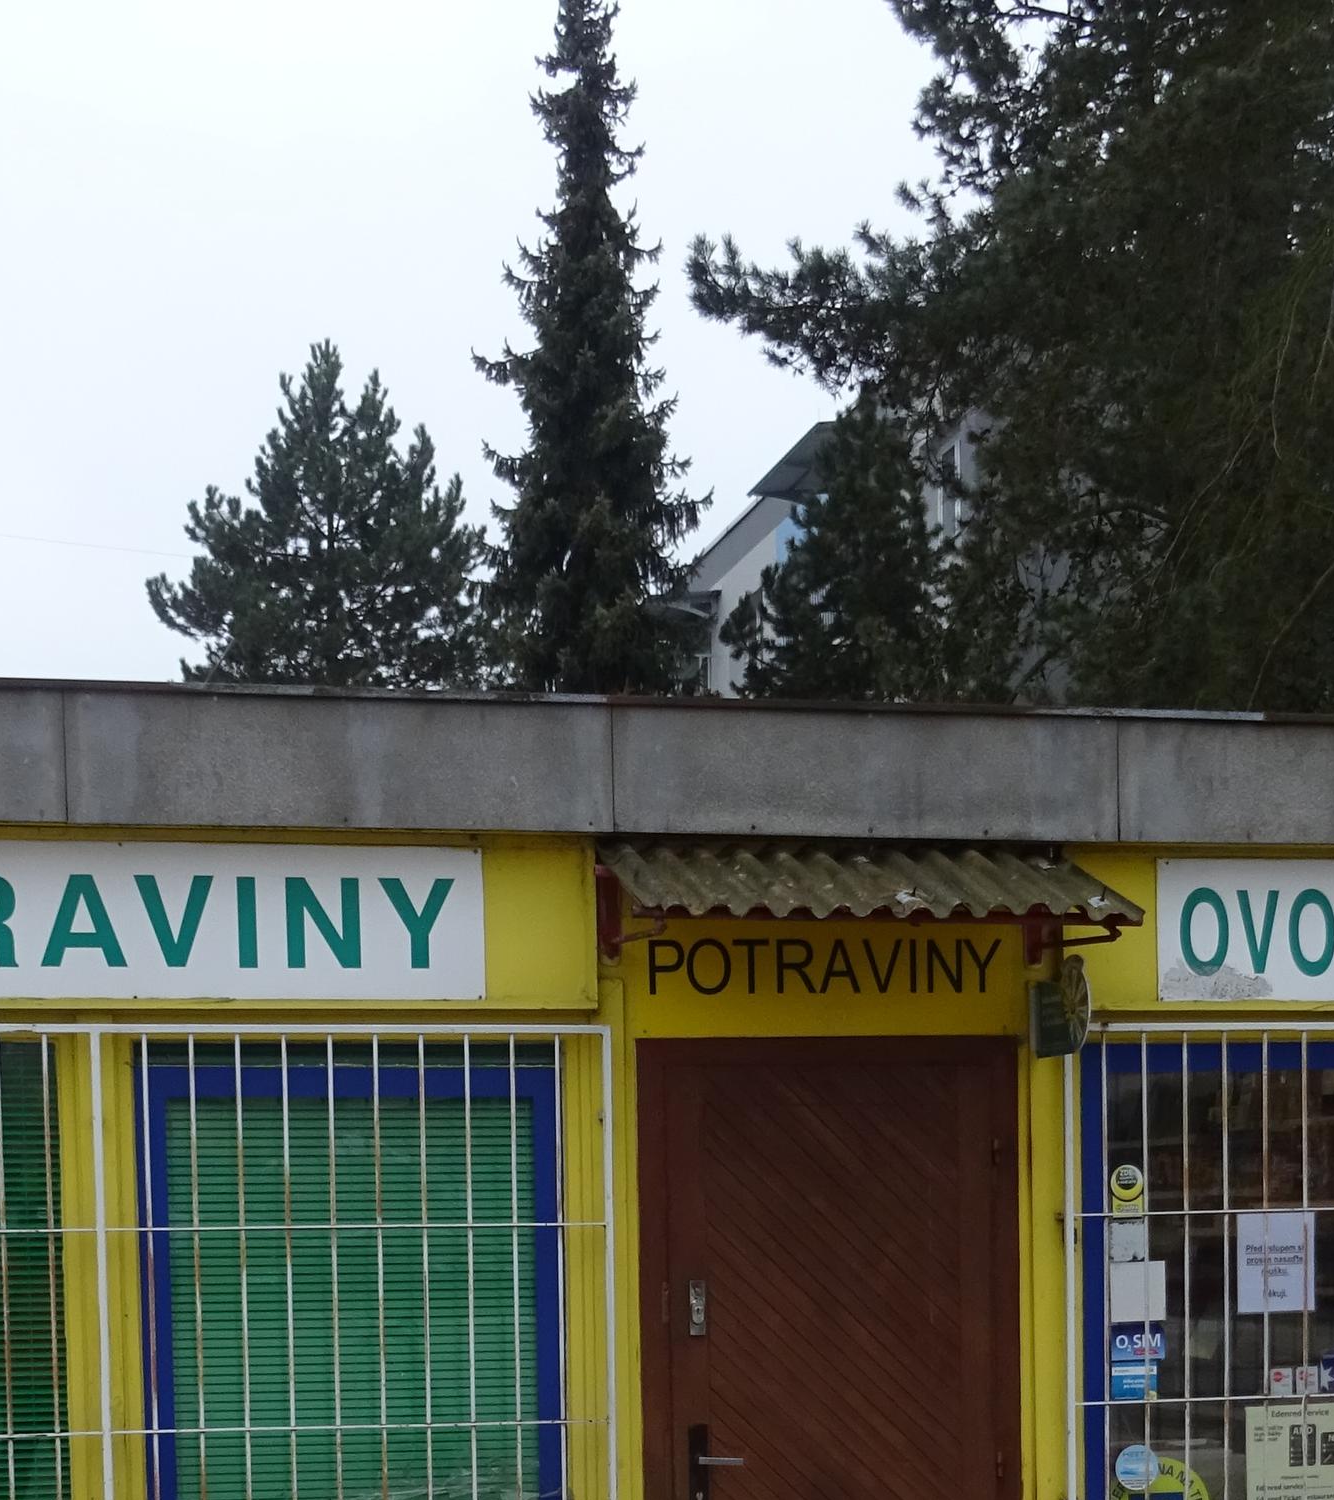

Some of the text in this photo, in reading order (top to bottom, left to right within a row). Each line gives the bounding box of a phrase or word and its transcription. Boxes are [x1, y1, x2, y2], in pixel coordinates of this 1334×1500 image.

[648, 938, 1002, 995] POTRAVINY
[1265, 1244, 1296, 1254] stupem
[1246, 1256, 1272, 1265] prosm
[1133, 1333, 1161, 1348] SIM
[1303, 1409, 1329, 1417] ervice
